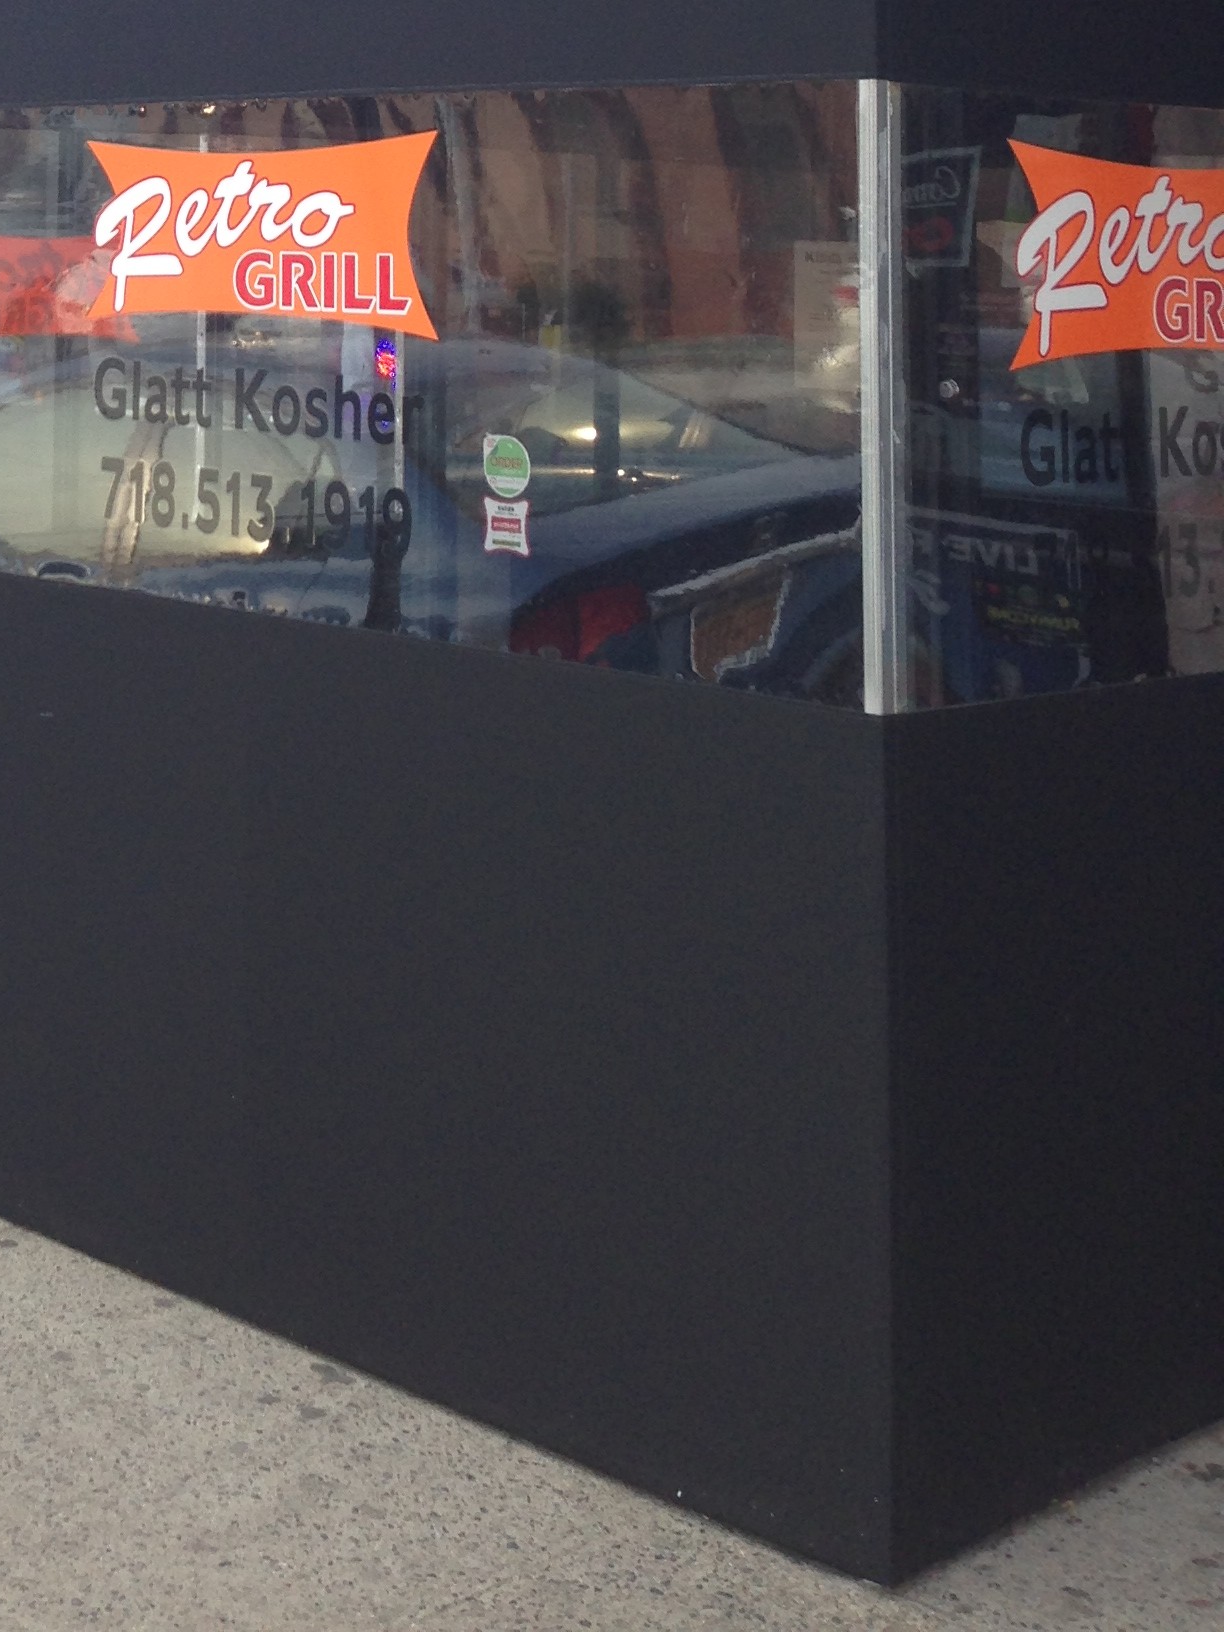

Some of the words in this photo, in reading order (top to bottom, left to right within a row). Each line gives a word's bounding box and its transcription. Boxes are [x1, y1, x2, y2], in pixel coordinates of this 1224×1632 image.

[95, 160, 355, 312] Retro
[233, 249, 412, 316] GRILL
[94, 357, 212, 428] Glatt
[235, 368, 424, 445] Kosher
[101, 456, 412, 555] 718.513.1919
